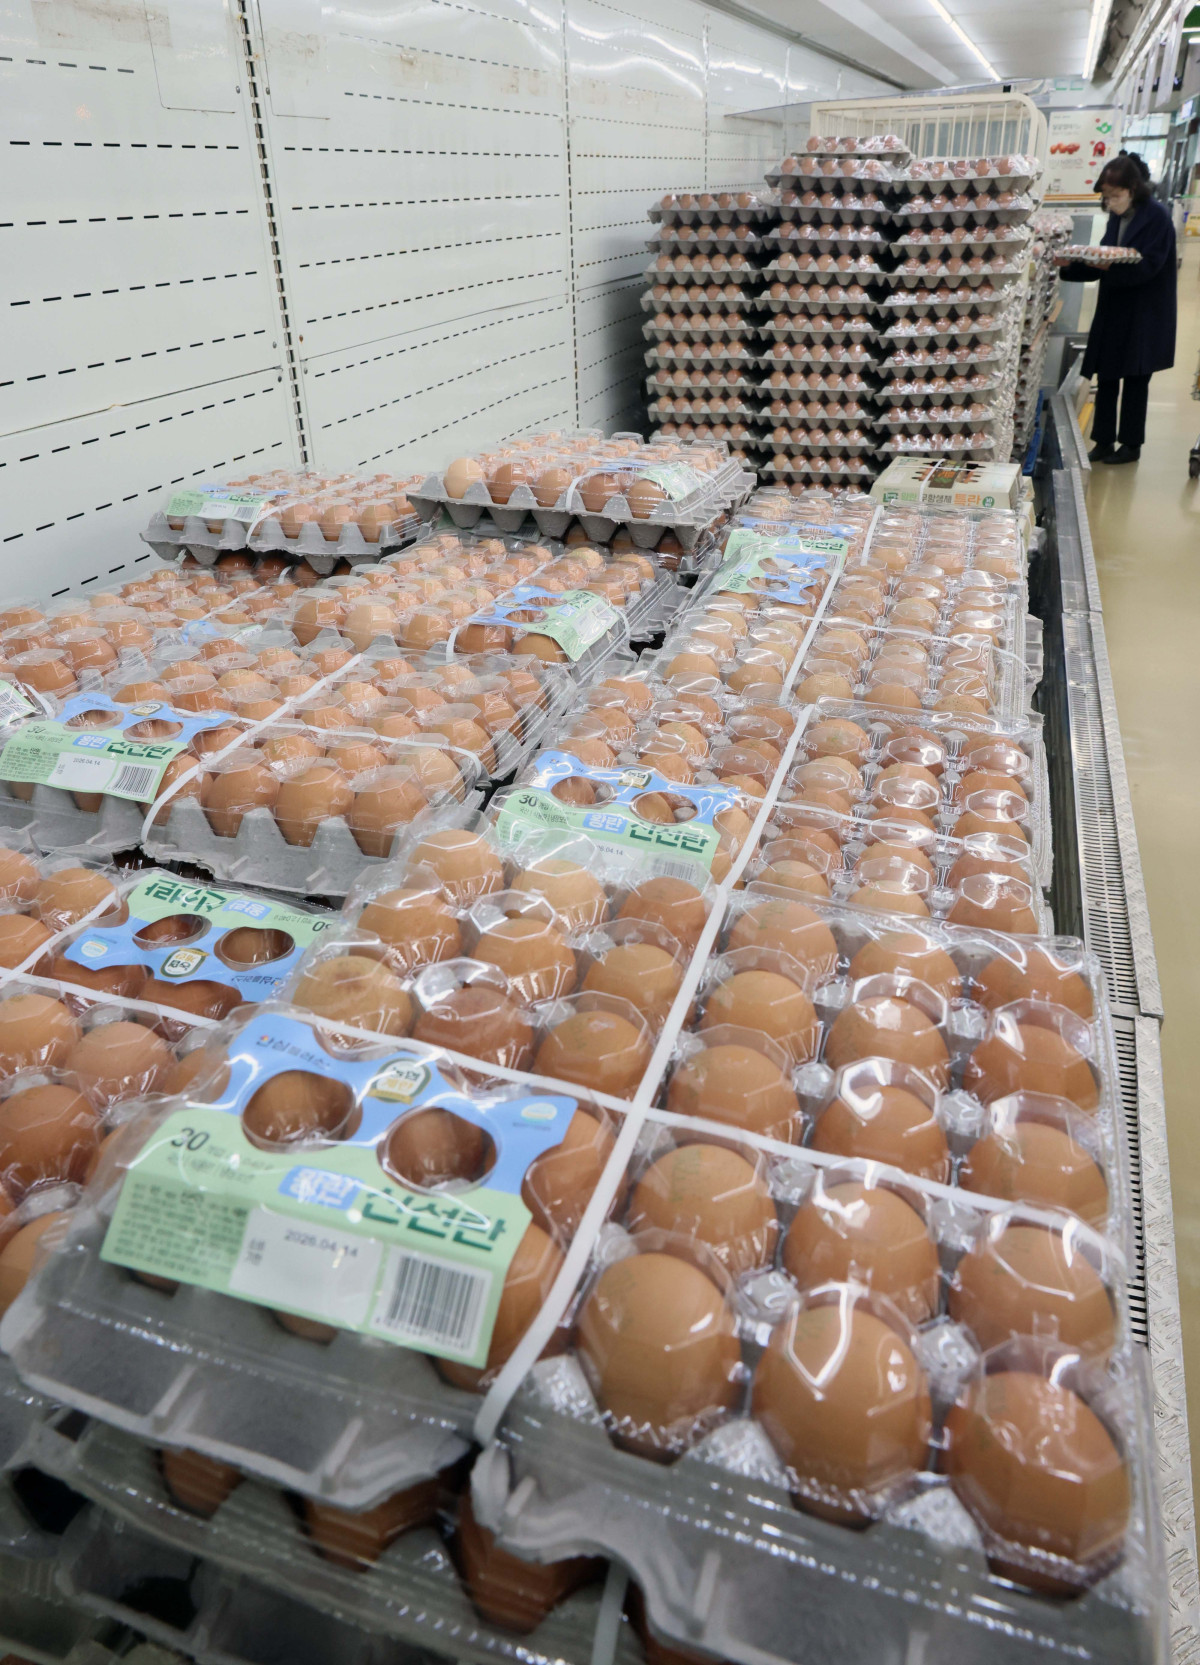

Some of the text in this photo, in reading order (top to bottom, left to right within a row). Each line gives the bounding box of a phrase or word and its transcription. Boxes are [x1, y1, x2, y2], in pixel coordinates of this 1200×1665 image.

[106, 741, 174, 760] 신선란
[519, 794, 538, 807] 30
[589, 813, 623, 832] 왕란
[629, 821, 709, 854] 신선란
[145, 879, 228, 913] 신선란
[230, 901, 266, 918] 왕란
[167, 959, 191, 972] 농협
[171, 1127, 210, 1151] 30
[289, 1168, 354, 1205] 왕란
[362, 1187, 507, 1252] 신선란
[284, 1229, 358, 1258] 2026.04.14
